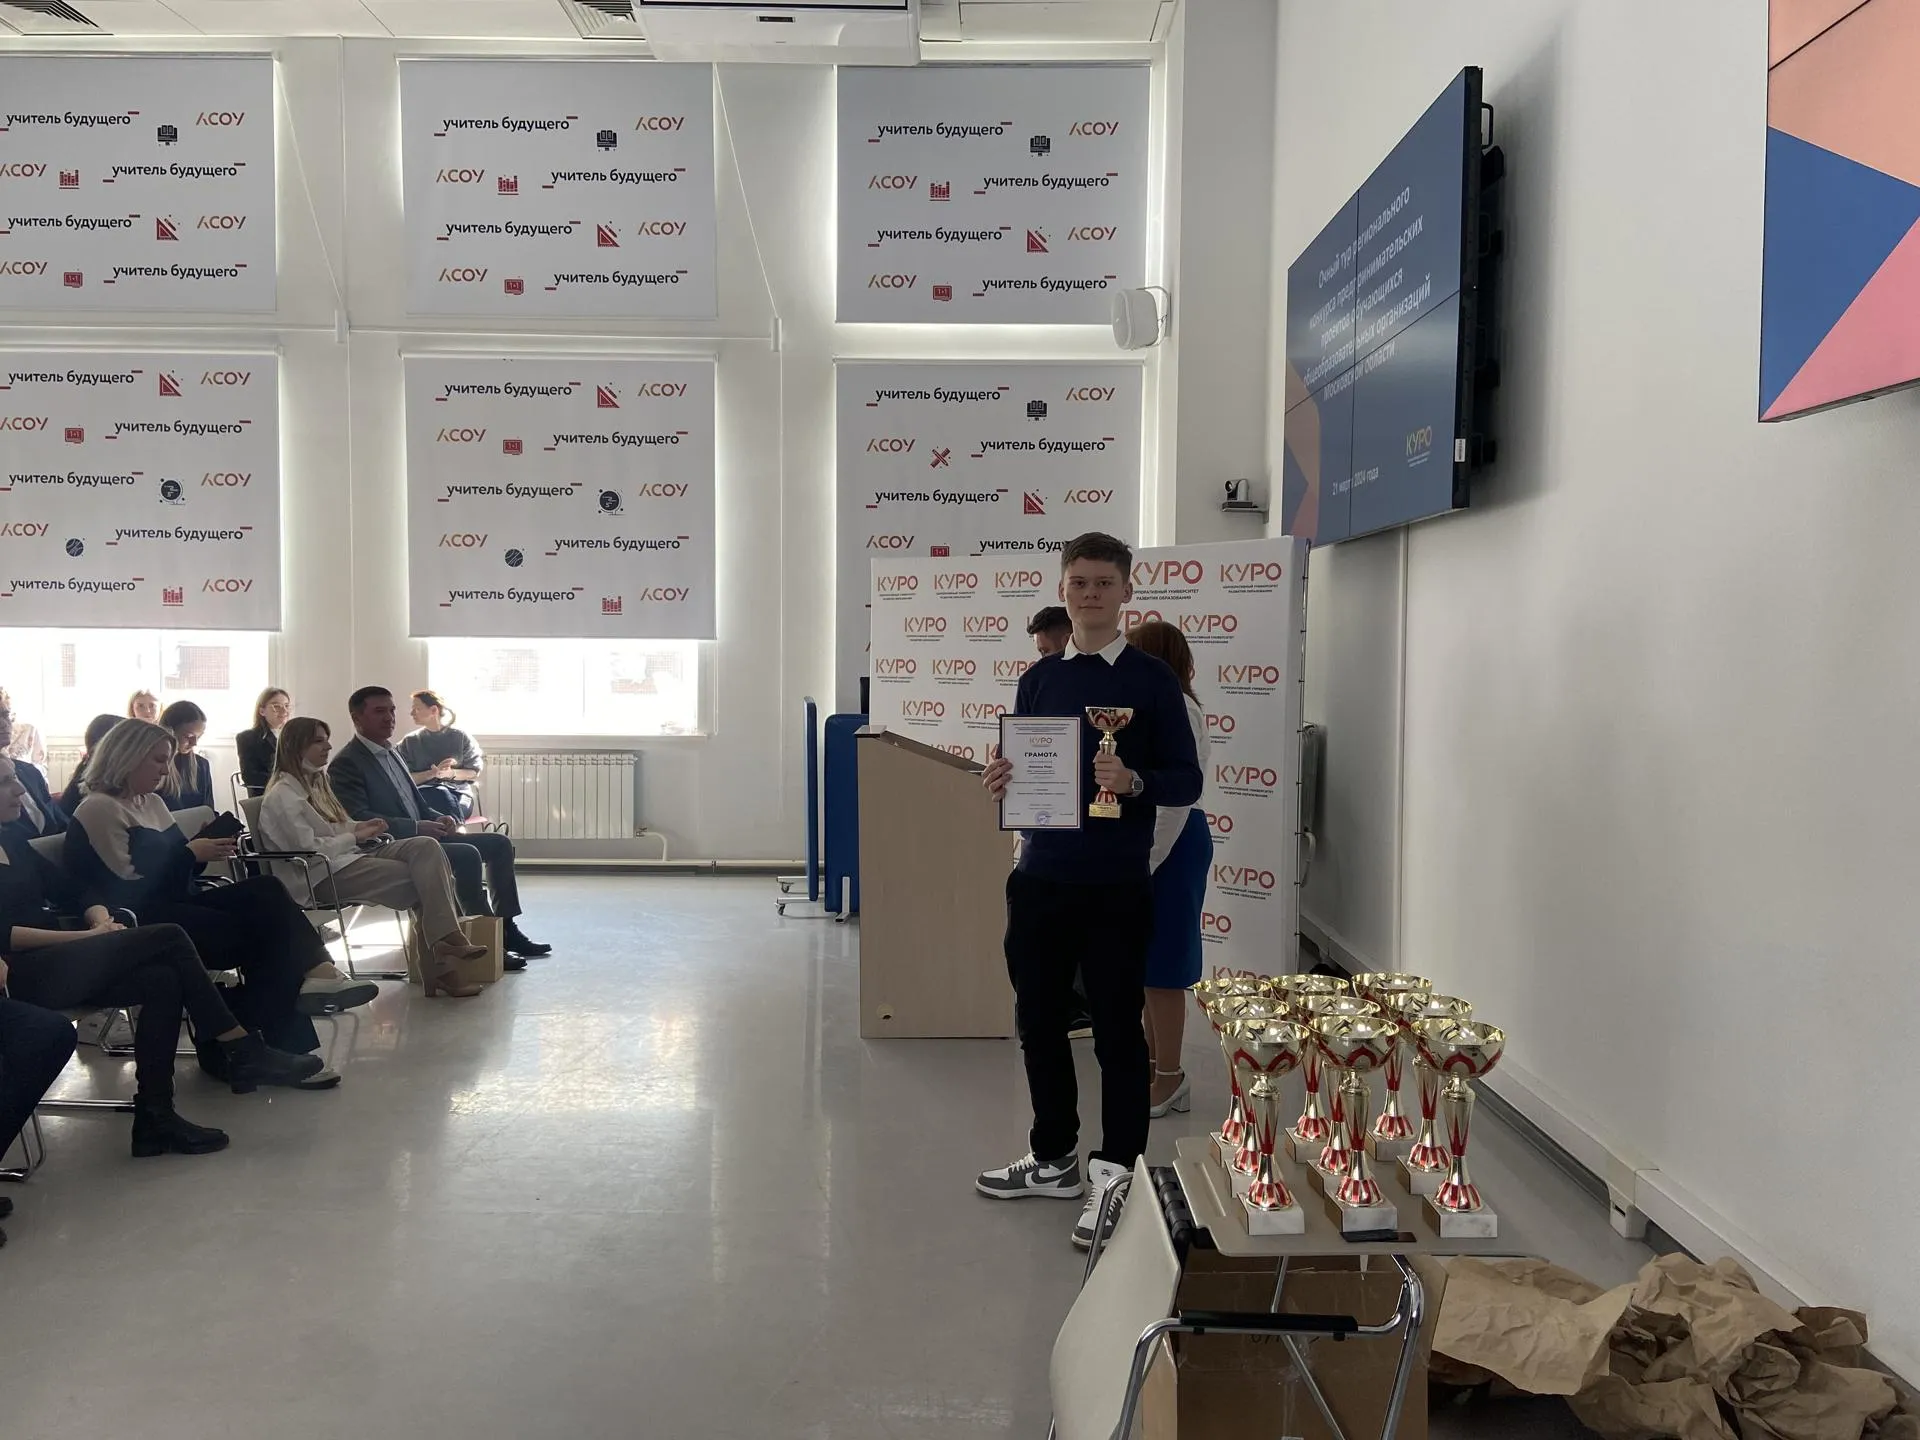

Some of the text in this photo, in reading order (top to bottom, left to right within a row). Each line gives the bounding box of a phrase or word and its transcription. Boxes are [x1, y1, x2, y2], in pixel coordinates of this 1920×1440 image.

[7, 111, 130, 127] учитель будущего
[443, 116, 569, 132] учитель будущего
[878, 122, 1003, 138] учитель будущего
[112, 163, 237, 179] учитель будущего
[551, 168, 677, 184] учитель будущего
[983, 173, 1109, 190] учитель будущего
[8, 214, 131, 230] учитель будущего
[446, 221, 572, 237] учитель будущего
[877, 227, 1002, 243] учитель будущего
[113, 264, 238, 280] учитель будущего
[554, 270, 679, 286] учитель будущего
[982, 276, 1107, 292] учитель будущего
[1376, 272, 1431, 336] организаций
[9, 370, 134, 386] учитель будущего
[445, 382, 572, 398] учитель будущего
[876, 387, 1000, 403] учитель будущего
[115, 420, 242, 436] учитель будущего
[553, 431, 679, 447] учитель будущего
[981, 438, 1105, 453] учитель будущего
[1406, 425, 1432, 457] КУРО
[11, 472, 135, 487] учитель будущего
[447, 483, 573, 498] учитель будущего
[877, 489, 999, 505] учитель будущего
[115, 527, 243, 542] учитель будущего
[555, 536, 680, 551] учитель будущего
[979, 540, 1034, 552] учитель
[995, 571, 1042, 588] КУРО
[1220, 562, 1282, 582] КУРО
[11, 577, 136, 593] учитель будущего
[878, 575, 918, 592] КУРО
[934, 573, 978, 590] КУРО
[449, 587, 575, 603] учитель будущего
[905, 616, 947, 632] КУРО
[964, 616, 1008, 632] КУРО
[1179, 614, 1237, 632] КУРО
[876, 659, 916, 674] КУРО
[933, 659, 976, 676] КУРО
[1218, 665, 1280, 684] КУРО
[902, 700, 945, 717] КУРО
[961, 703, 1007, 719] КУРО
[1205, 714, 1236, 733] РО
[1215, 764, 1278, 787] КУРО
[1205, 814, 1234, 833] РО
[1213, 864, 1275, 889] КУРО
[1202, 912, 1232, 933] РО
